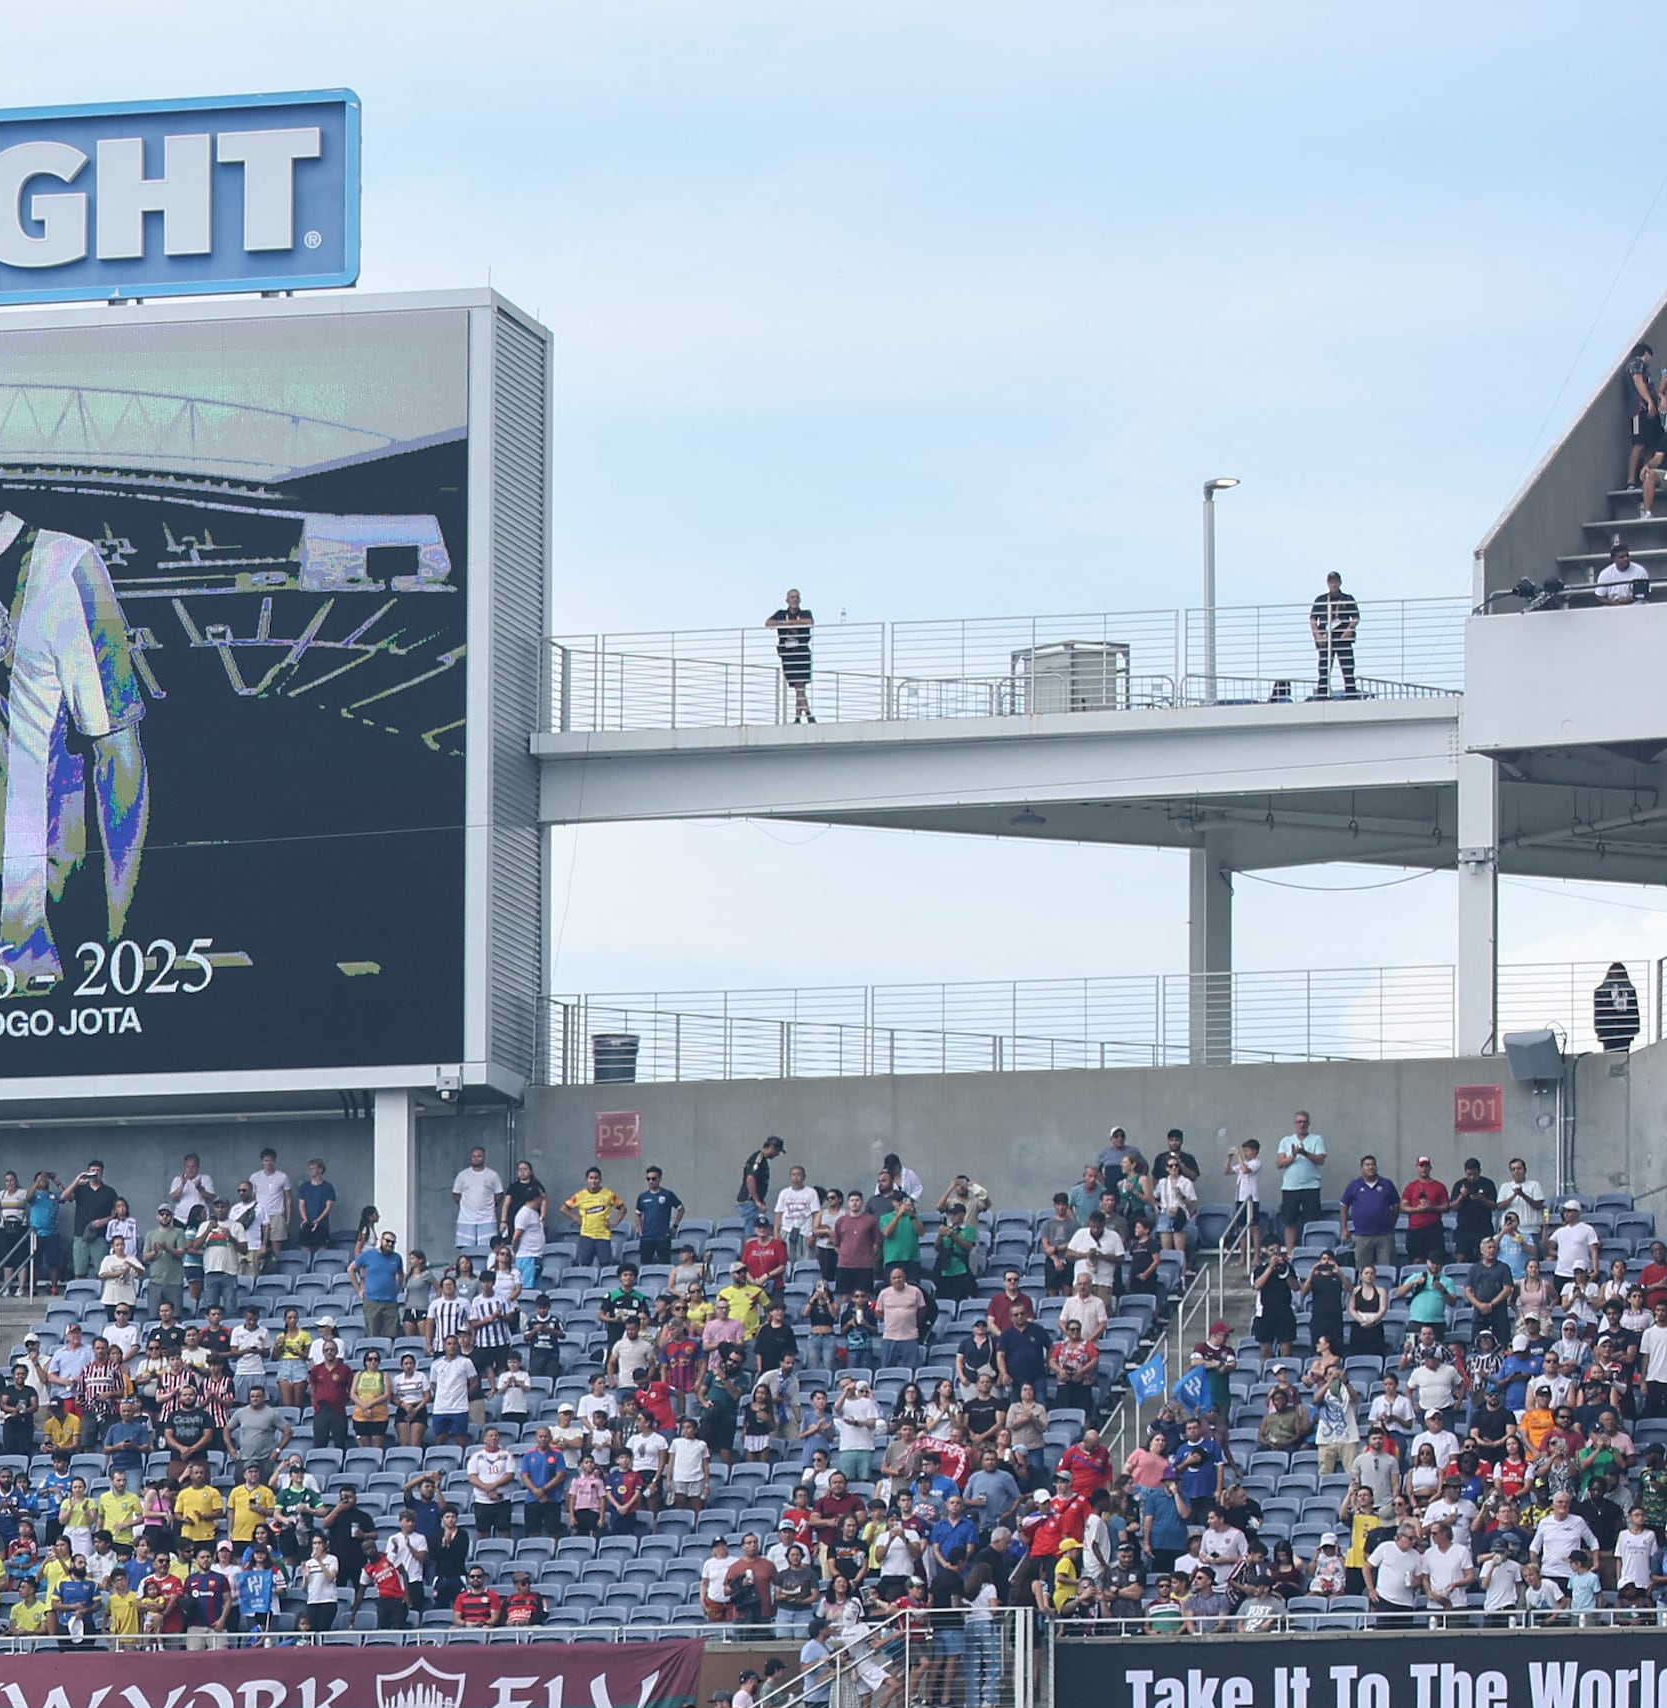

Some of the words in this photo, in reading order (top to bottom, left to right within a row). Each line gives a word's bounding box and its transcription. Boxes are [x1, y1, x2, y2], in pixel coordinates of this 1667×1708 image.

[73, 937, 214, 1005] 2025
[58, 1005, 142, 1035] JOTA
[1457, 1098, 1496, 1121] P01
[598, 1124, 639, 1147] P52
